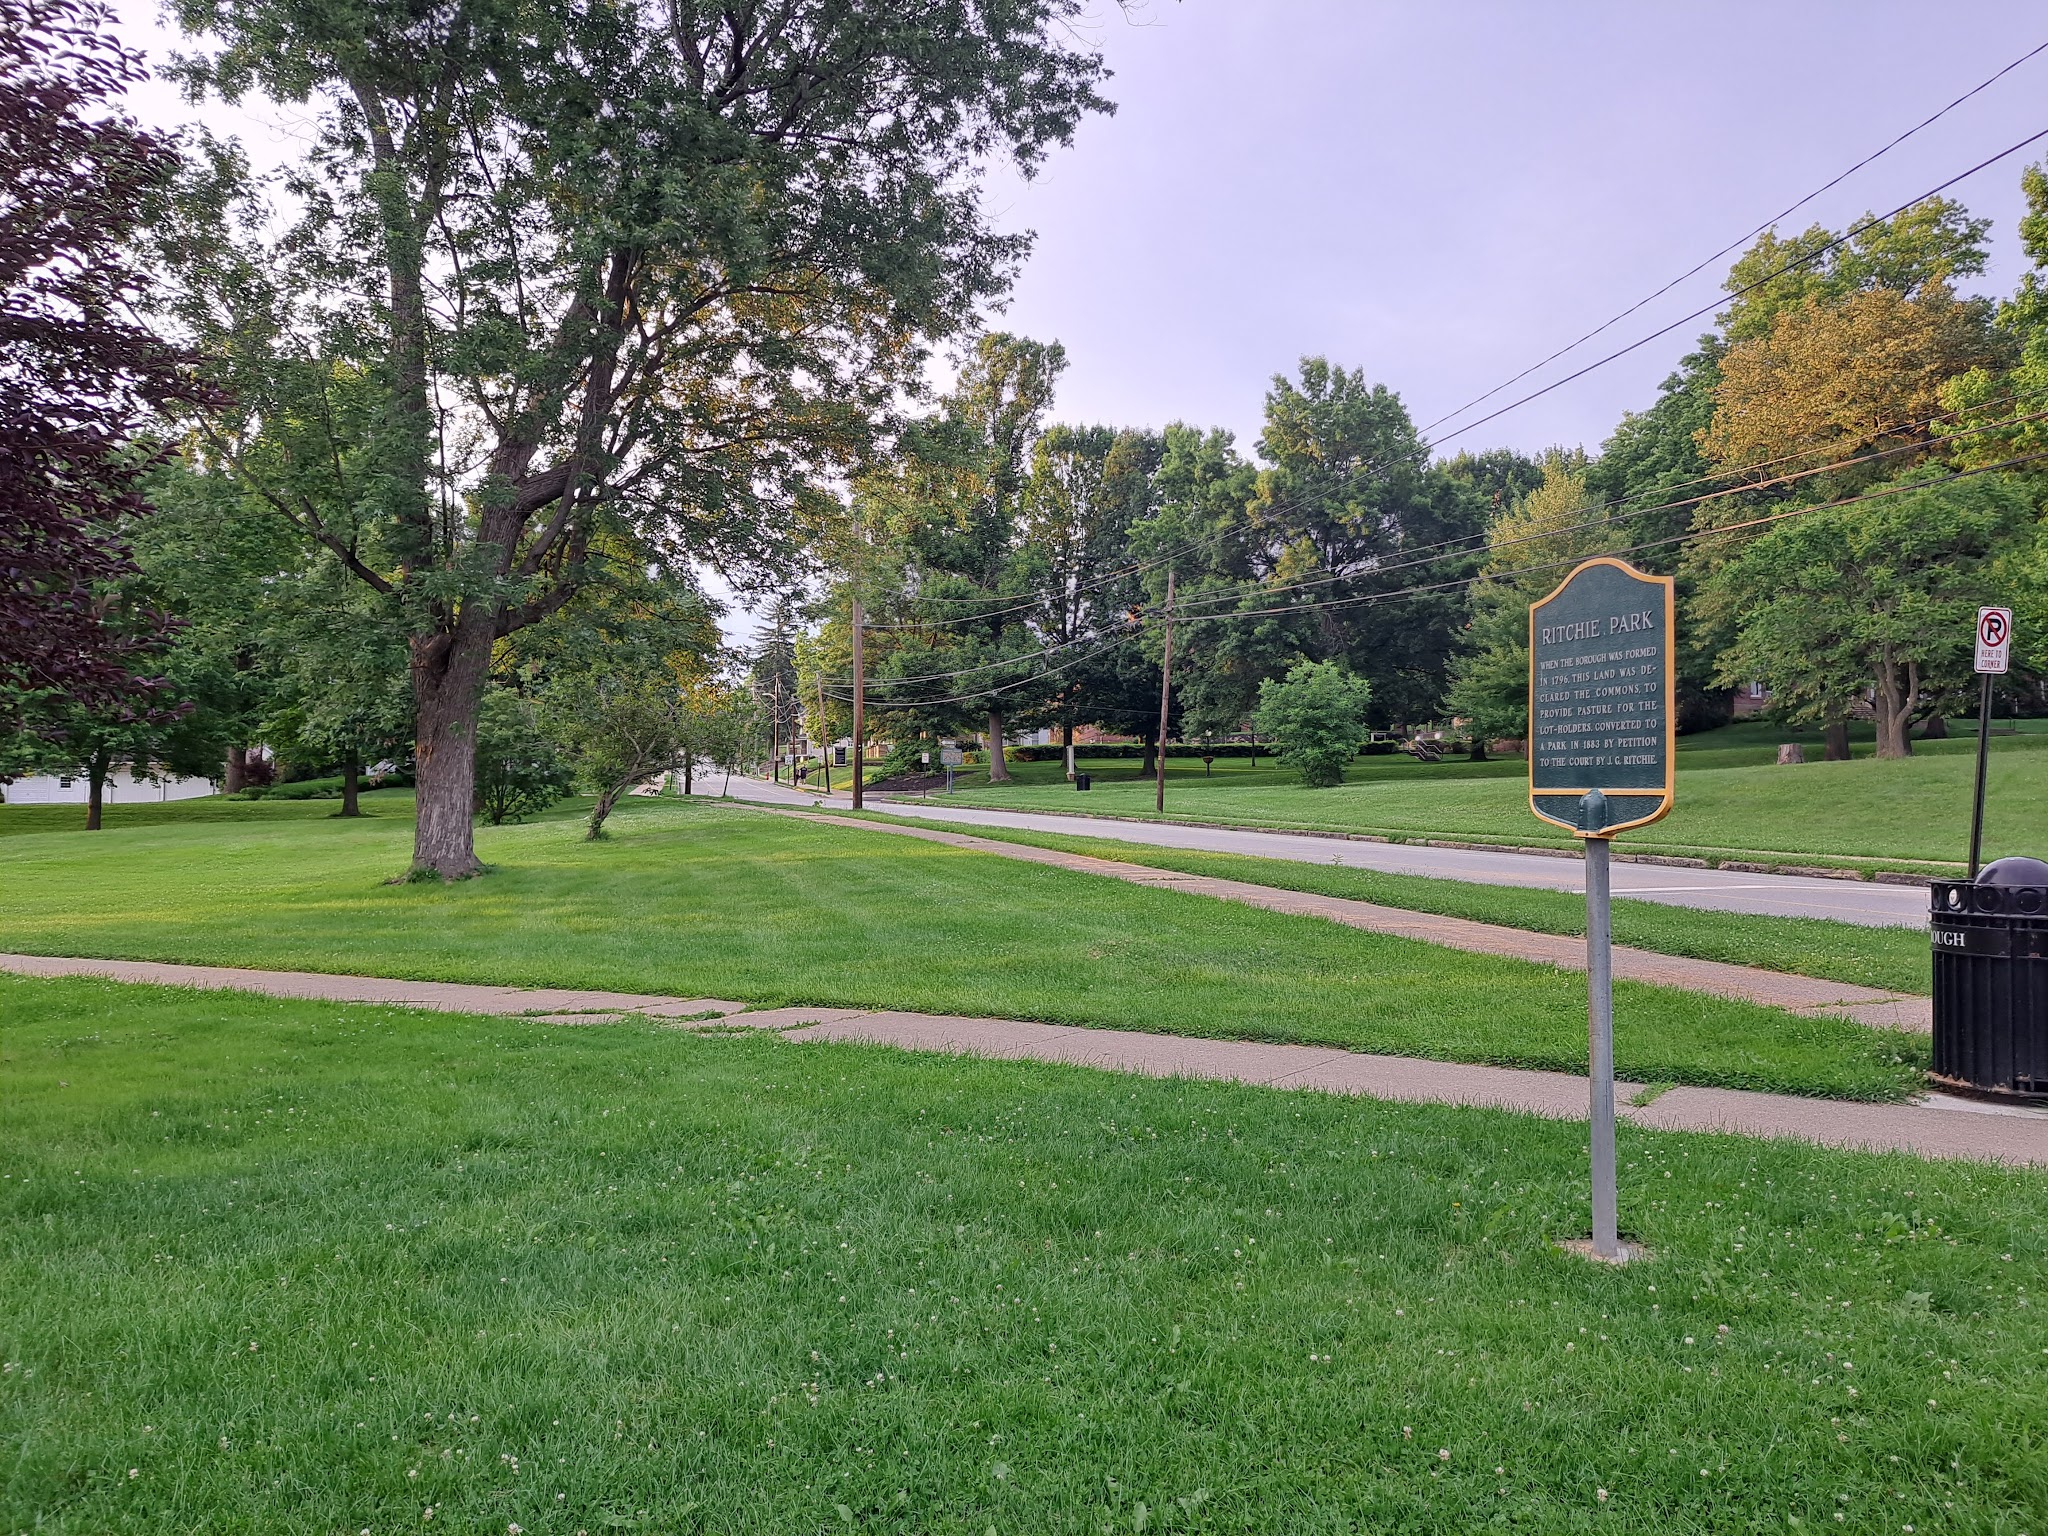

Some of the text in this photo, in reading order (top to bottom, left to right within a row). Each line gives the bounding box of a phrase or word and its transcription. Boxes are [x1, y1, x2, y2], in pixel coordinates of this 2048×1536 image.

[1542, 610, 1654, 645] RITCHIE PARK
[1540, 647, 1657, 670] WHEN THE BOROUGH WAS FORMED
[1981, 649, 2003, 658] HERE TO
[1981, 660, 2001, 669] CORNER
[1540, 677, 1548, 687] IN
[1572, 671, 1590, 683] THIS
[1594, 669, 1616, 681] LAND
[1620, 666, 1636, 678] WAS
[1641, 665, 1657, 675] DE-
[1540, 691, 1570, 703] CLARED
[1574, 689, 1591, 700] THE
[1644, 682, 1657, 693] TO
[1540, 700, 1657, 719] PROVIDE PASTURE FOR THE
[1595, 719, 1642, 731] CONVERTED
[1645, 718, 1657, 729] TO
[1540, 736, 1657, 751] A PARK IN 1883 BY PETITION
[1540, 758, 1550, 767] TO
[1551, 757, 1566, 767] THE
[1569, 756, 1594, 767] COURT
[1596, 755, 1606, 766] BY
[1930, 930, 1966, 947] OUGH
